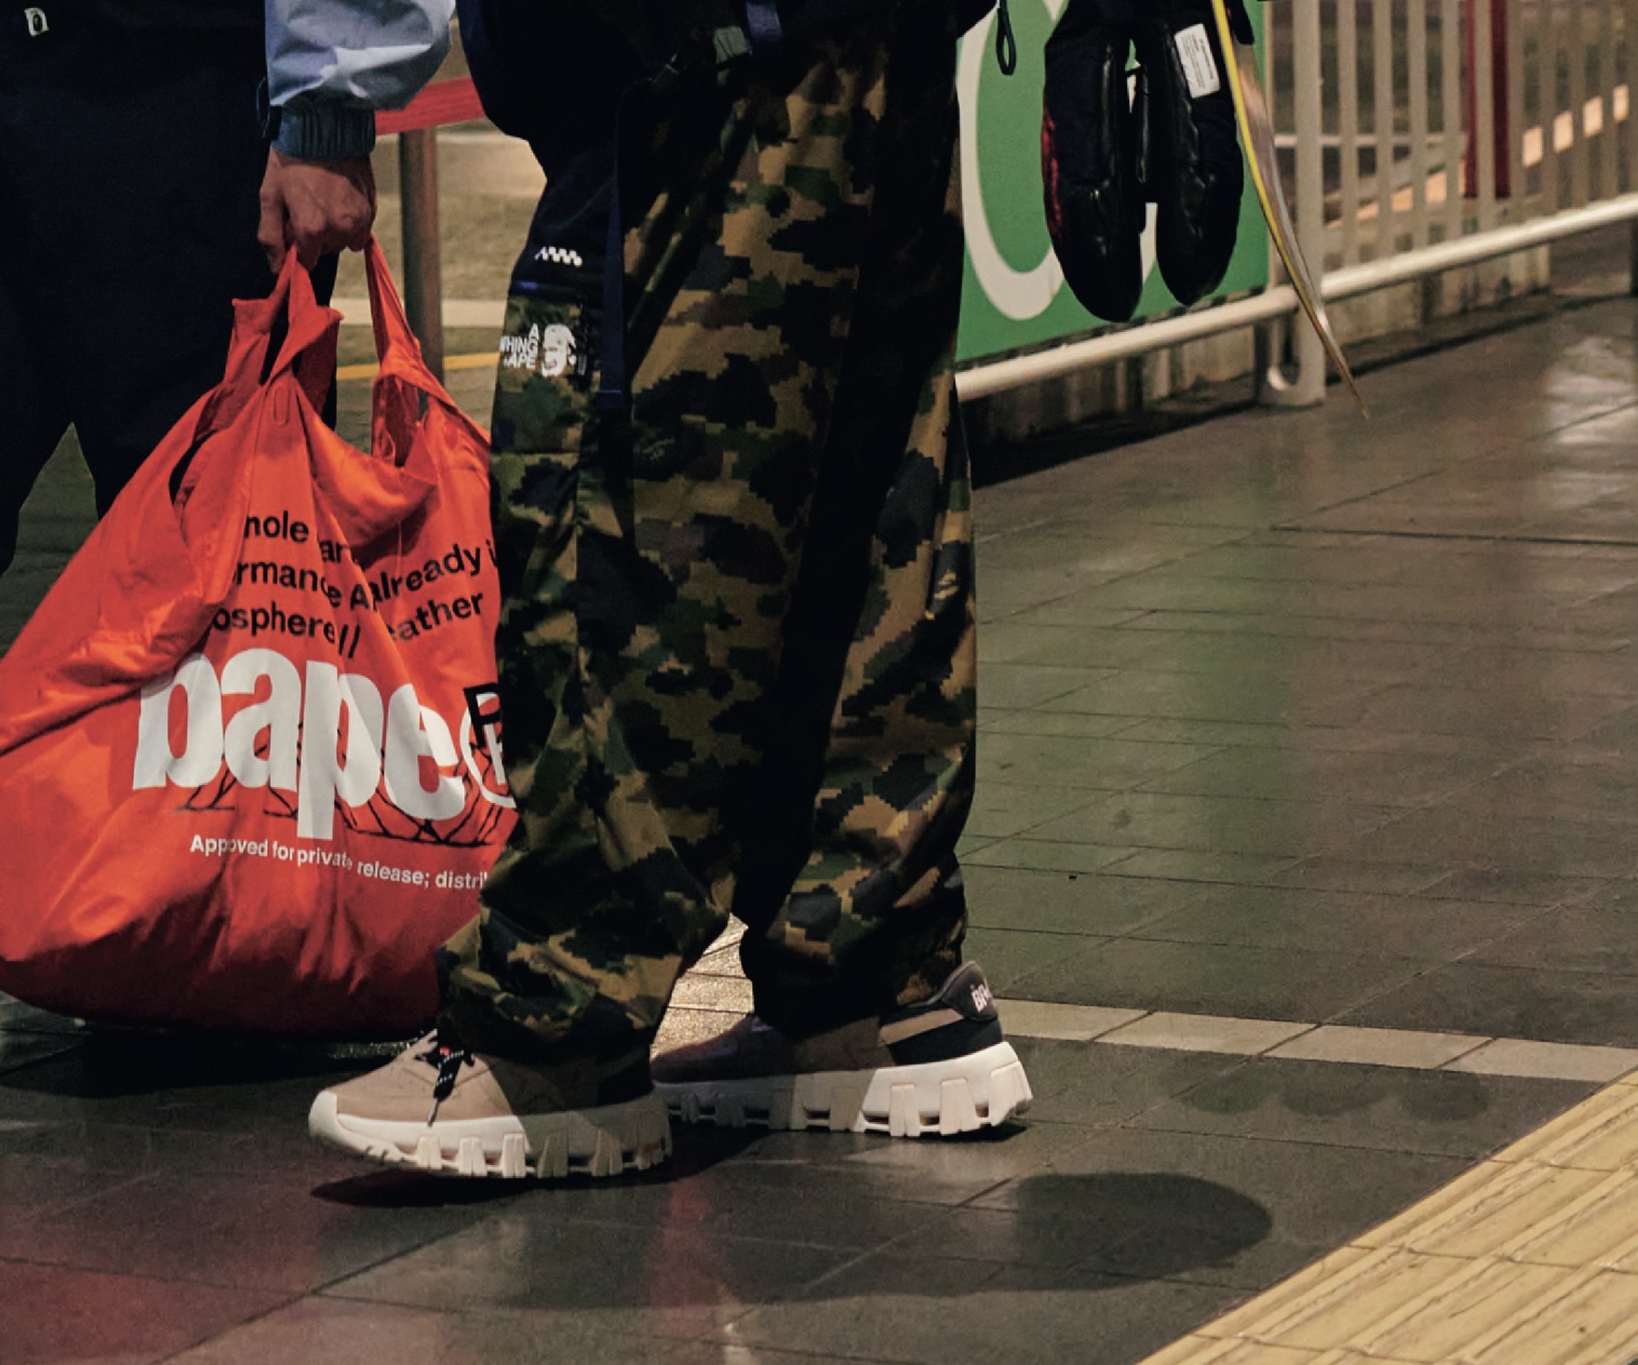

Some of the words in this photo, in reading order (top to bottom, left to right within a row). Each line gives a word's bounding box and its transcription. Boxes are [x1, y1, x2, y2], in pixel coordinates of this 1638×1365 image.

[132, 648, 465, 841] bape
[272, 842, 294, 861] for
[357, 860, 430, 889] release;
[435, 871, 488, 890] distri
